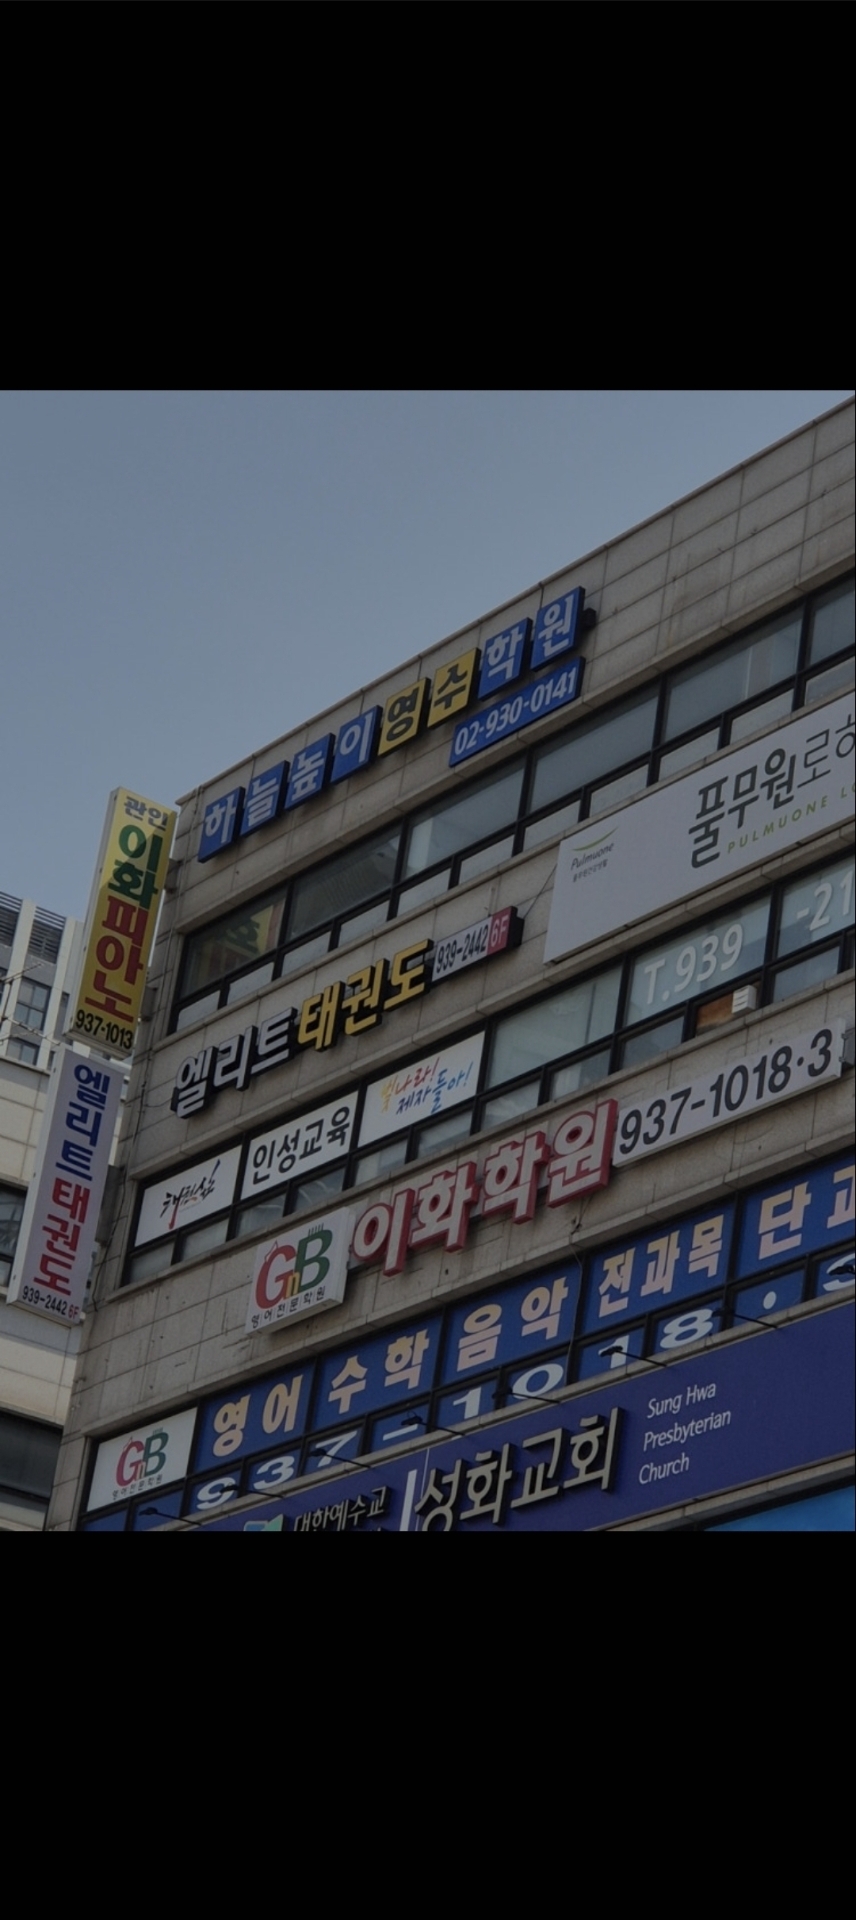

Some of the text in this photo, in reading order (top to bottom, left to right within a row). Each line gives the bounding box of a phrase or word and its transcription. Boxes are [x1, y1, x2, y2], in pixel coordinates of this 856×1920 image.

[454, 666, 577, 757] 02-930-0141
[124, 795, 168, 831] 관인
[727, 795, 828, 853] PULMUONE
[570, 843, 614, 871] Pulmuone
[85, 824, 163, 1023] 이화피아노
[436, 928, 488, 974] 939-2442
[490, 916, 508, 947] 6F
[644, 923, 743, 1004] T.939
[75, 1009, 133, 1049] 937-1013
[253, 1106, 349, 1186] 인성교육
[352, 1101, 608, 1276] 이화학원
[22, 1285, 79, 1320] 939-2442 6F
[212, 1373, 304, 1457] 영어
[328, 1328, 429, 1415] 수학
[457, 1276, 568, 1372] 음악
[598, 1213, 724, 1318] 전과목
[646, 1379, 716, 1420] Sung Hwa
[643, 1410, 731, 1452] Presbyterian
[414, 1407, 618, 1531] 성화교회
[638, 1453, 689, 1485] Church
